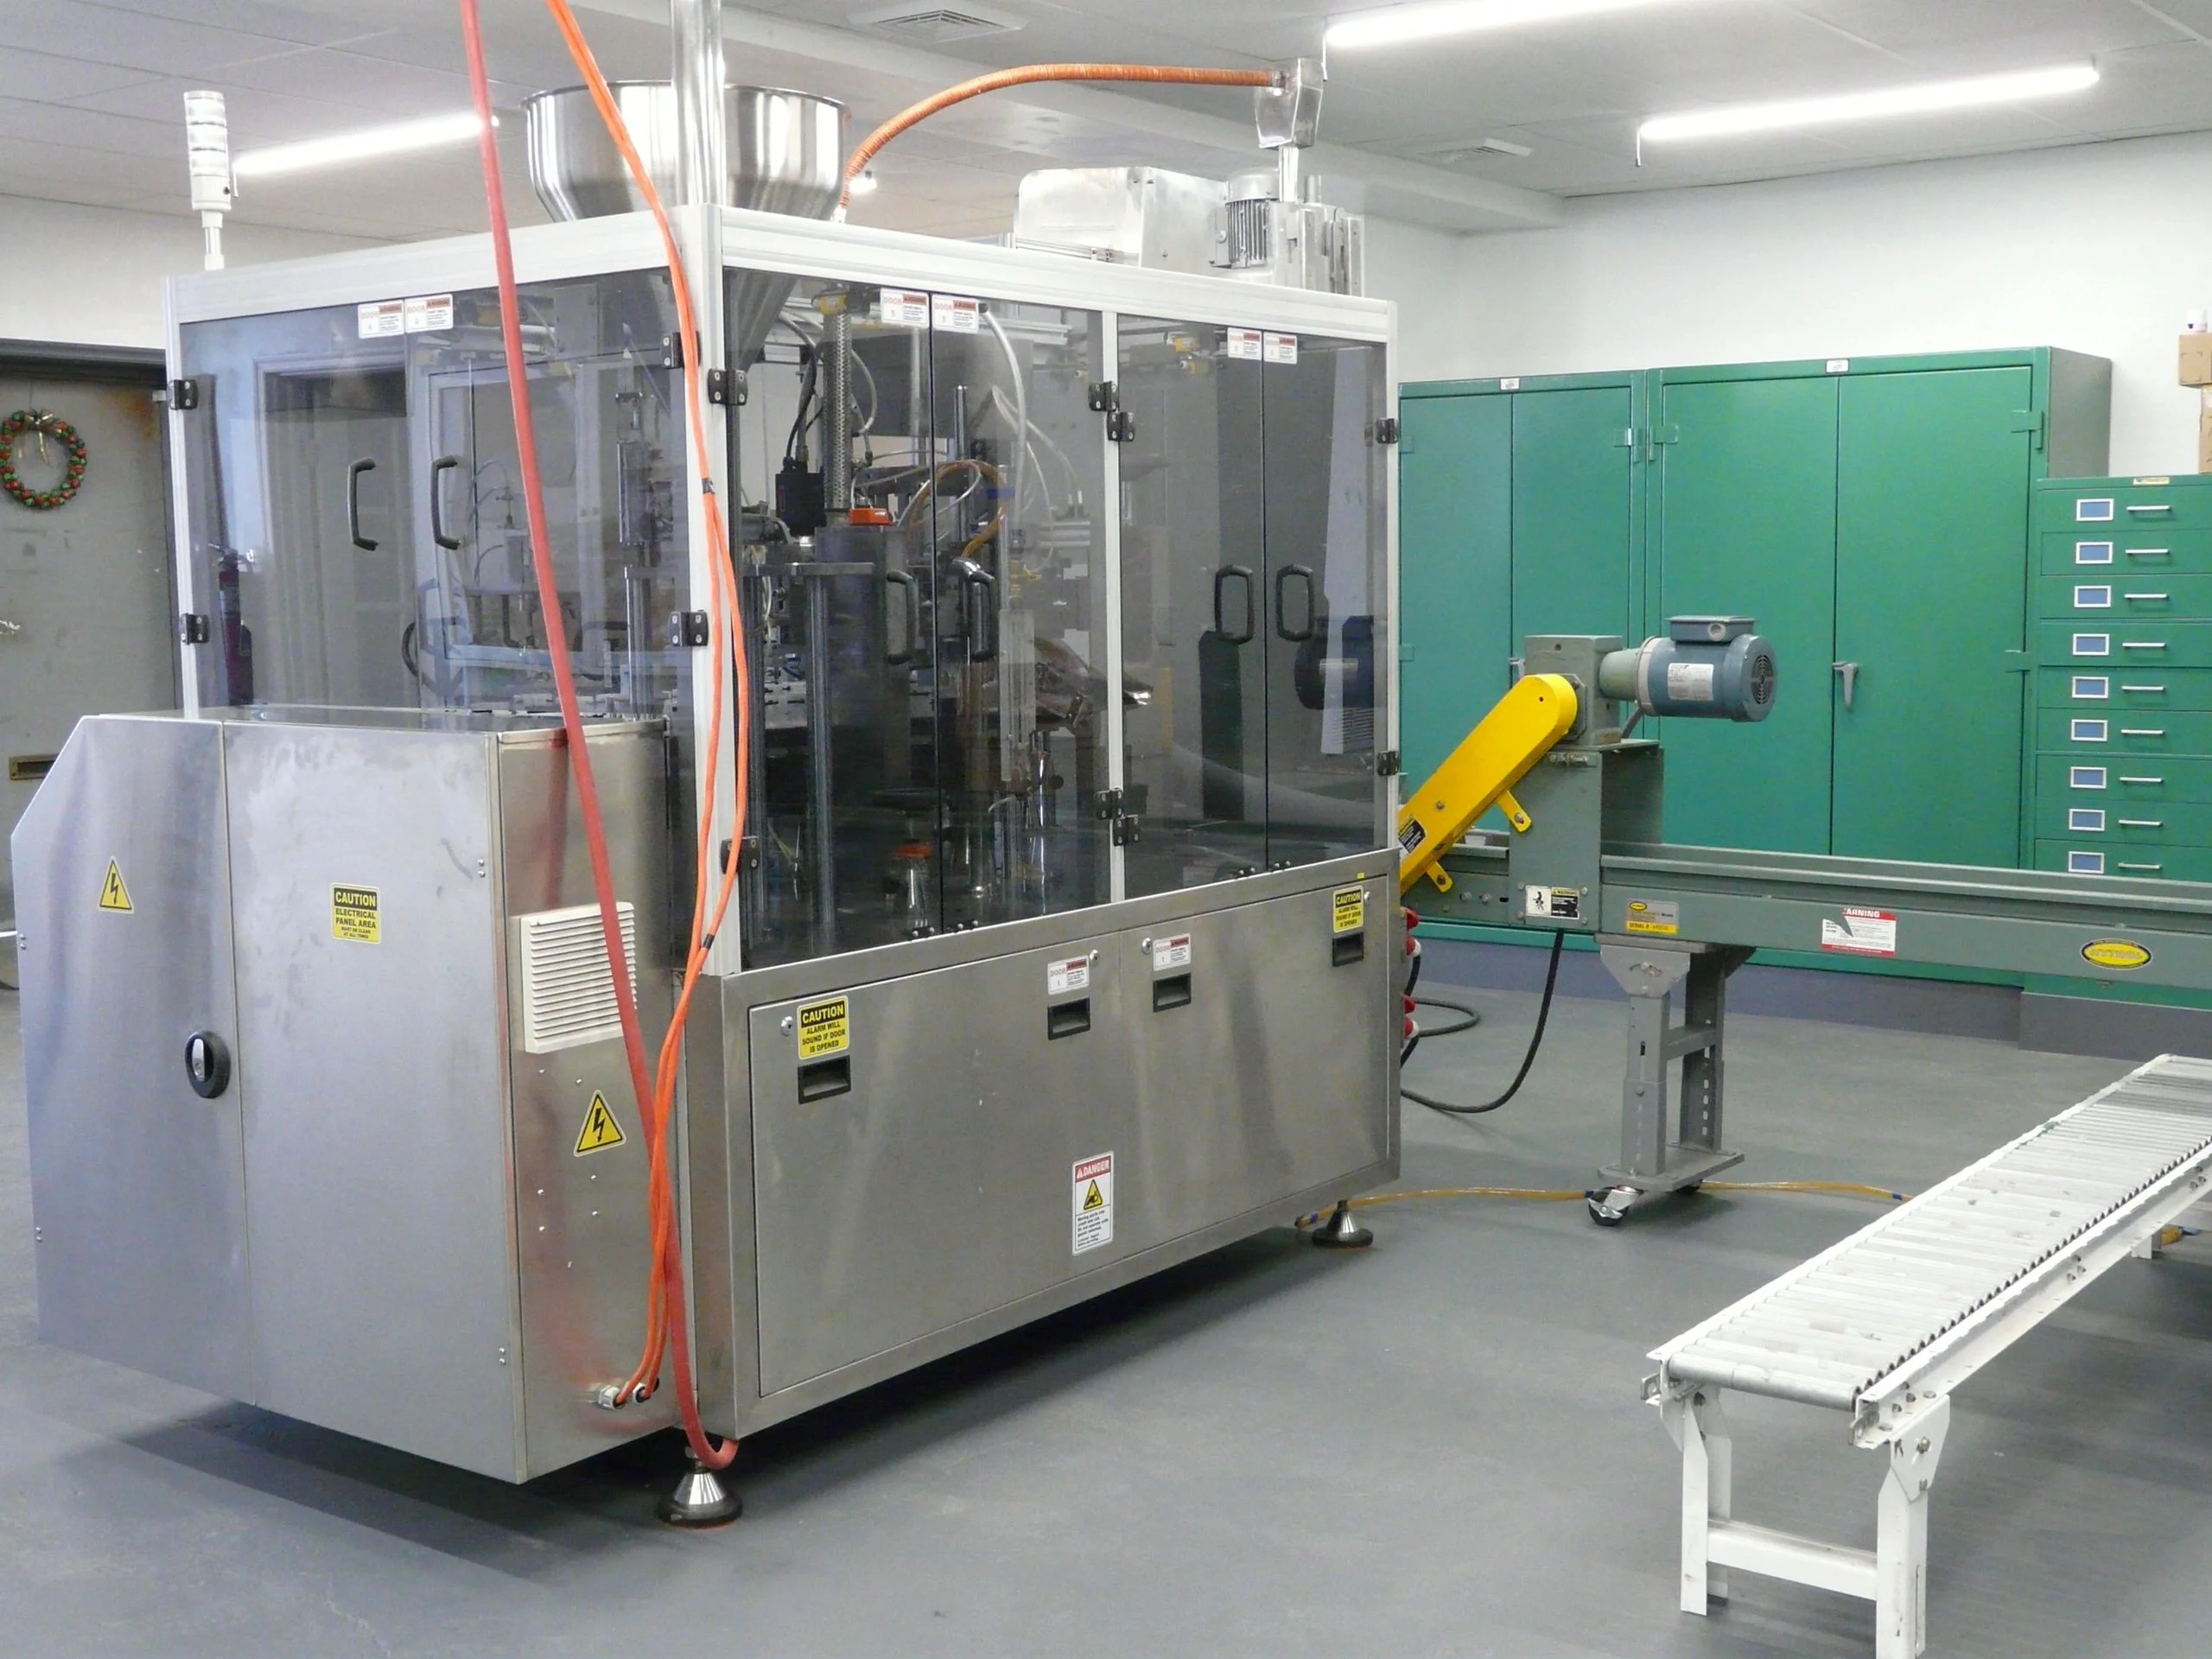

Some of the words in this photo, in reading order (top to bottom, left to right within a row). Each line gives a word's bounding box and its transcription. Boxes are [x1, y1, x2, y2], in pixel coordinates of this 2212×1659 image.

[335, 891, 376, 907] CAUTION
[1336, 892, 1361, 905] CAUTION
[335, 907, 377, 919] ELECTRICAL
[1842, 907, 1881, 918] ARNING
[335, 917, 357, 926] PANEL
[358, 920, 377, 929] AREA
[802, 1003, 844, 1024] CAUTION
[806, 1024, 826, 1034] ALARM
[827, 1020, 841, 1029] WILL
[802, 1035, 822, 1046] SOUND
[830, 1029, 846, 1039] DOOR
[817, 1039, 839, 1051] OPENED
[1084, 1159, 1110, 1175] DANGER
